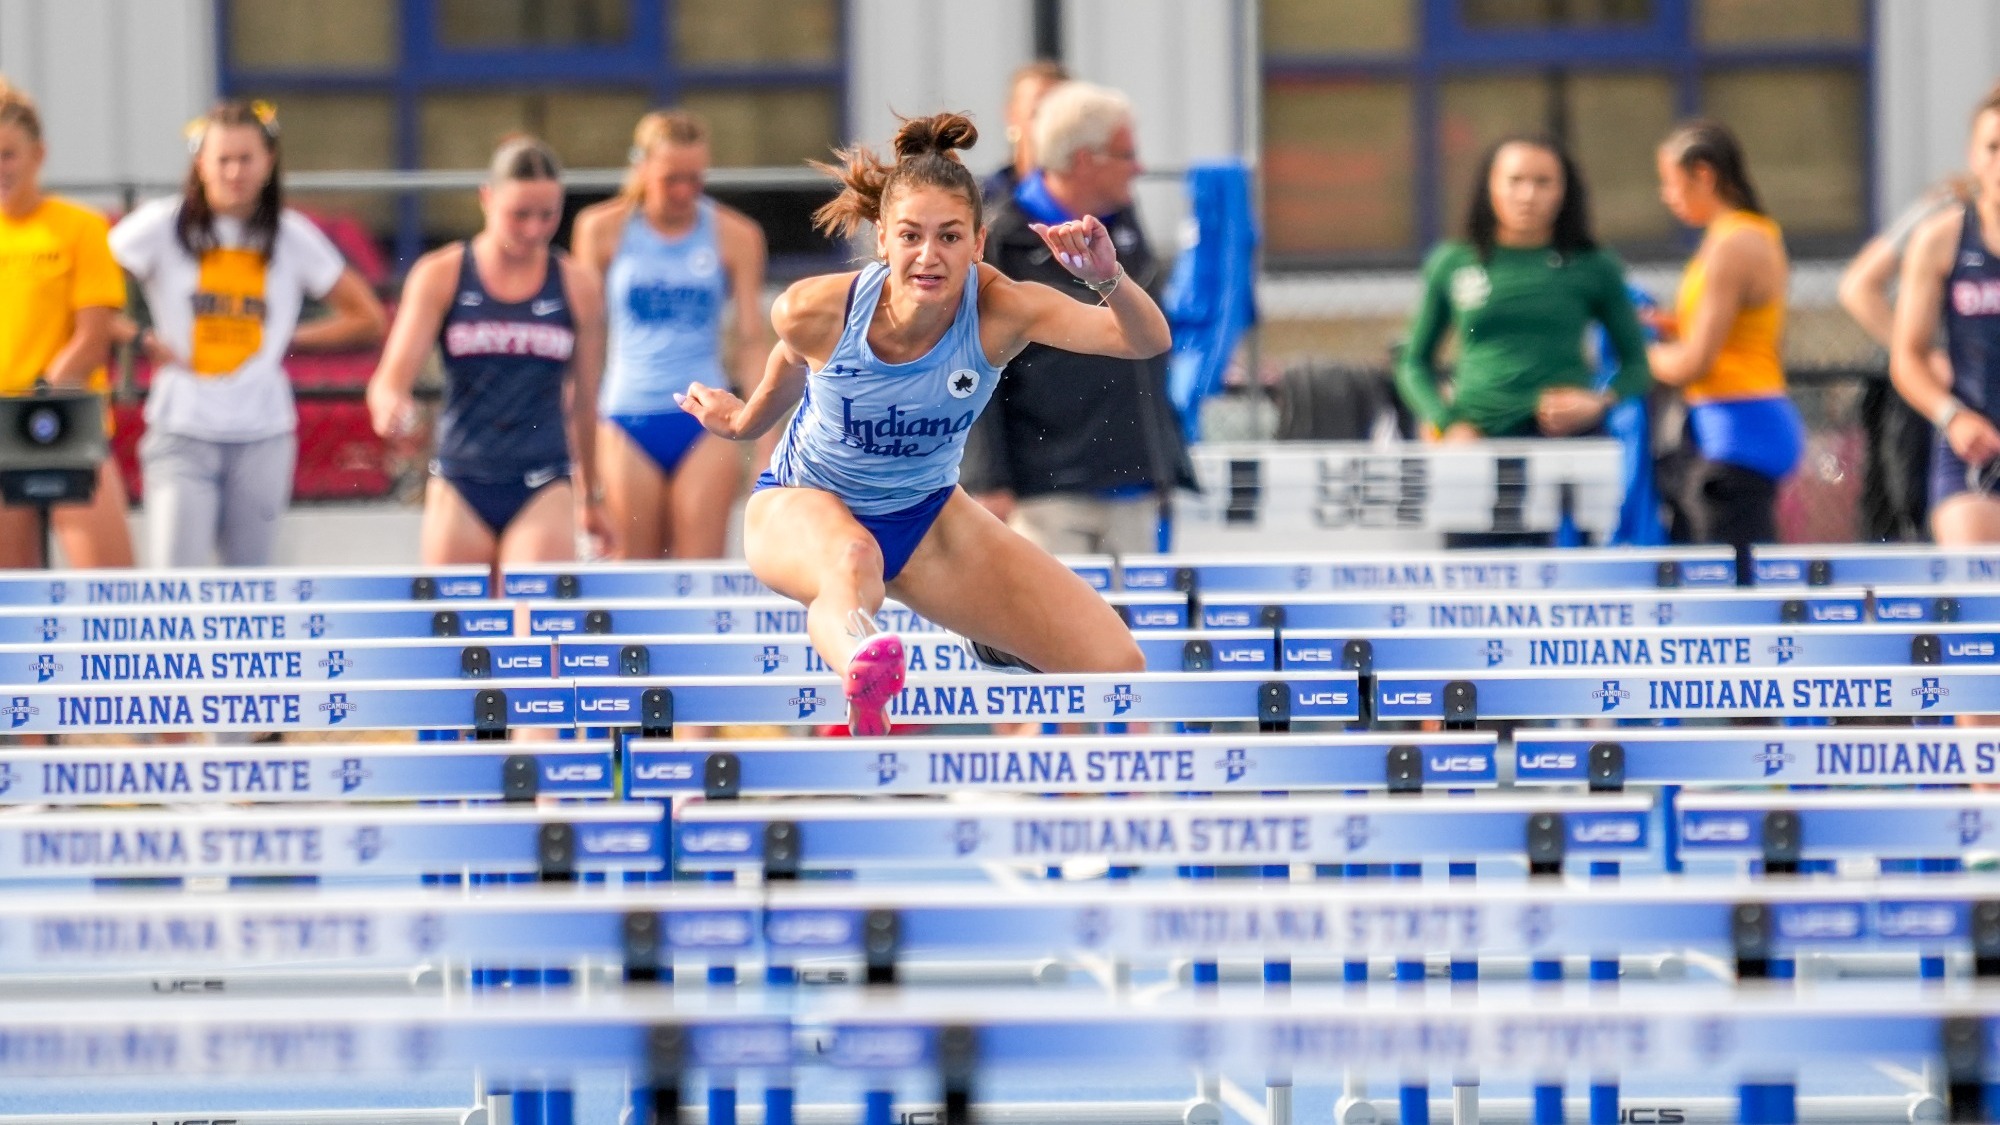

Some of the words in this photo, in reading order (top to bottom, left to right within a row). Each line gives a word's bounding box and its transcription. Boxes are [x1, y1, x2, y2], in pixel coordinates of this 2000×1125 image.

[842, 397, 975, 444] Indiana
[89, 579, 192, 602] INDIANA
[200, 579, 278, 602] STATE
[875, 609, 936, 632] STA
[1430, 604, 1543, 628] INDIANA
[1549, 603, 1634, 627] STATE
[82, 617, 195, 642] INDIANA
[203, 615, 285, 639] STATE
[464, 618, 508, 632] UCS
[533, 618, 576, 632] UCS
[1219, 649, 1266, 663] UCS
[1286, 648, 1333, 662] UCS
[1530, 639, 1651, 666] INDIANA
[1660, 637, 1751, 665] STATE
[1948, 642, 1995, 657] UCS
[81, 654, 204, 680] INDIANA
[212, 652, 302, 678] STATE
[497, 656, 543, 669] UCS
[564, 654, 609, 668] UCS
[987, 684, 1086, 715] STATE
[1299, 692, 1349, 706] UCS
[1383, 692, 1433, 706] UCS
[1649, 680, 1784, 710] INDIANA
[1793, 678, 1893, 709] STATE
[58, 696, 194, 726] INDIANA
[202, 694, 301, 724] STATE
[514, 700, 565, 714] UCS
[580, 698, 631, 712] UCS
[929, 752, 1078, 784] INDIANA
[1087, 750, 1195, 782] STATE
[1430, 756, 1488, 772] UCS
[1520, 753, 1577, 769] UCS
[1816, 743, 1966, 775] INDIANA
[43, 761, 192, 794] INDIANA
[201, 760, 311, 792] STATE
[546, 766, 604, 781] UCS
[635, 764, 694, 780] UCS
[1013, 818, 1180, 855] INDIANA
[1189, 816, 1312, 853] STATE
[21, 830, 190, 866] INDIANA
[199, 827, 323, 864] STATE
[796, 970, 848, 984] CS
[1621, 1108, 1685, 1124] CS
